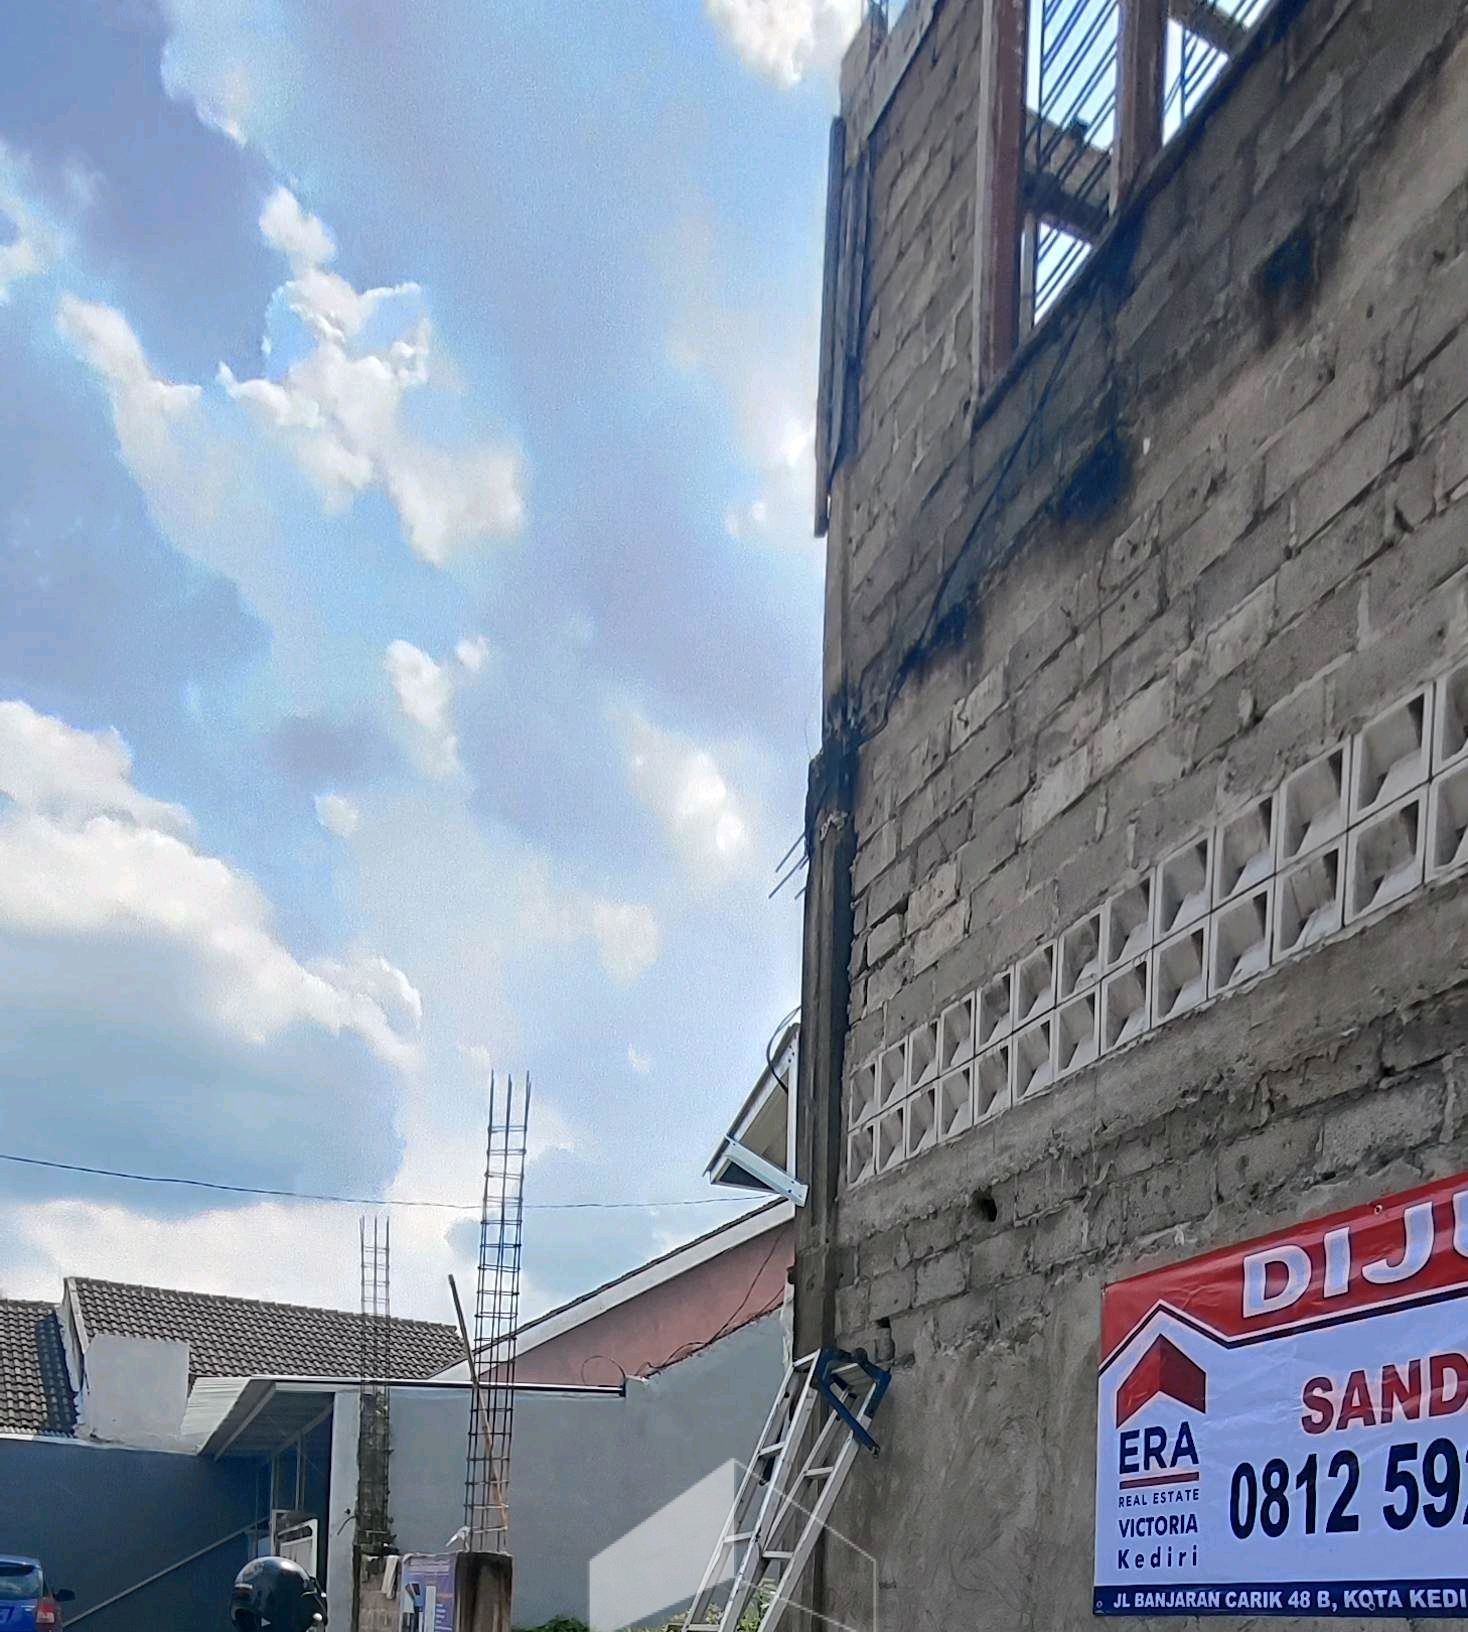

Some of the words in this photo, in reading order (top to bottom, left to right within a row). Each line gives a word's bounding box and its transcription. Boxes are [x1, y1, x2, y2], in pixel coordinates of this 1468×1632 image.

[1242, 1189, 1468, 1319] DIJ
[1119, 1421, 1199, 1475] ERA
[1118, 1495, 1147, 1508] REAL
[1152, 1488, 1200, 1505] ESTATE
[1229, 1449, 1360, 1540] 0812
[1382, 1437, 1468, 1531] 59
[1118, 1513, 1198, 1538] VICTORIA
[1117, 1545, 1198, 1570] Kediri
[1113, 1592, 1130, 1609] JL
[1134, 1591, 1220, 1609] BANJARAN
[1224, 1591, 1283, 1609] CARIK
[1286, 1590, 1310, 1609] 48
[1316, 1590, 1338, 1613] B,
[1343, 1588, 1403, 1609] KOTA
[1409, 1588, 1467, 1609] KEDI
